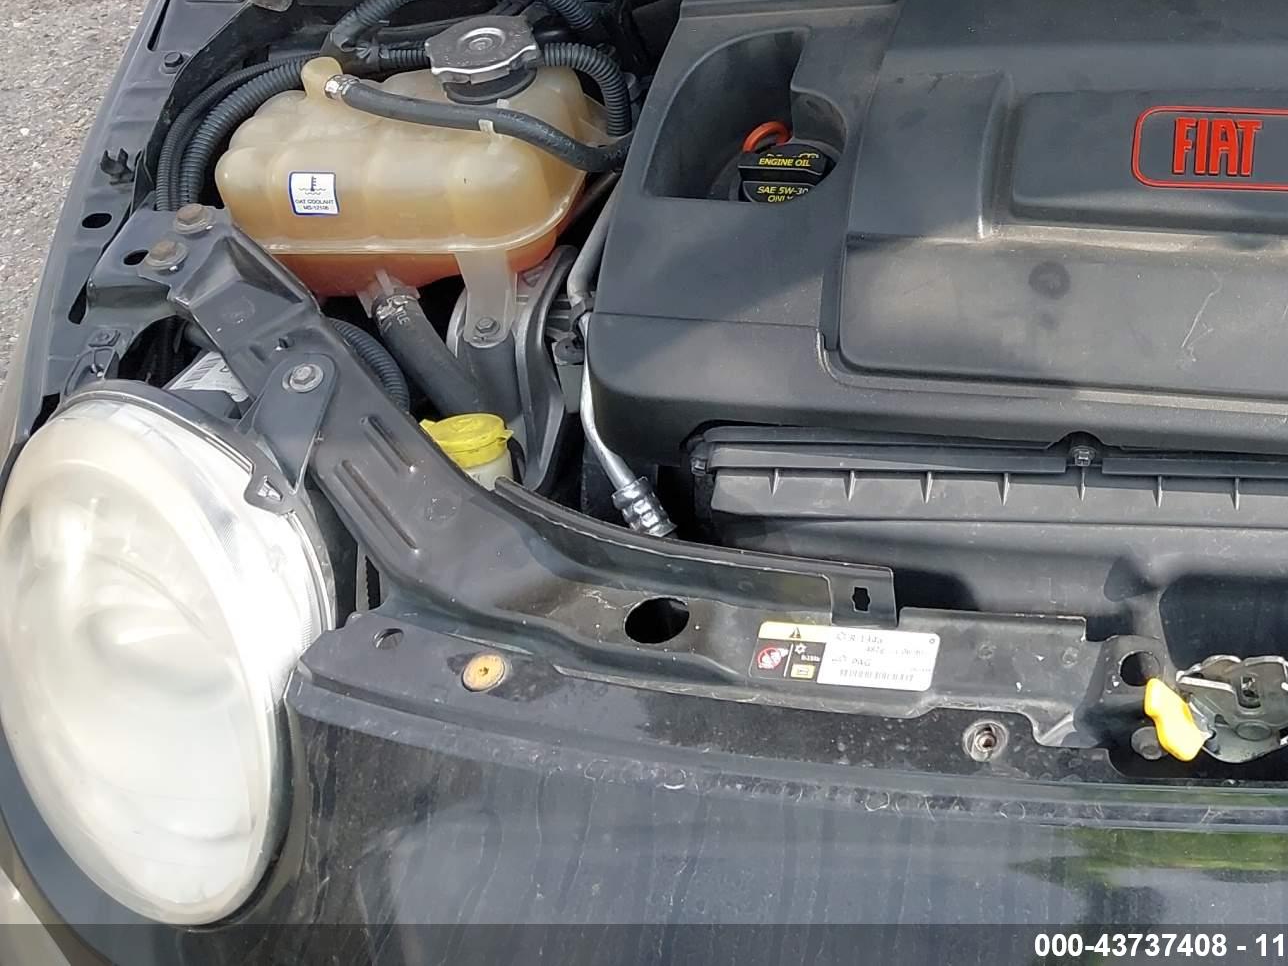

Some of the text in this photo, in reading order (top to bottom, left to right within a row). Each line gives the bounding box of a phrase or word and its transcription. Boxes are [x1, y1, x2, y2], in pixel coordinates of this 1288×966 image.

[1173, 118, 1262, 176] FIAT
[758, 157, 811, 167] ENGINE OIL
[757, 186, 777, 194] SAE
